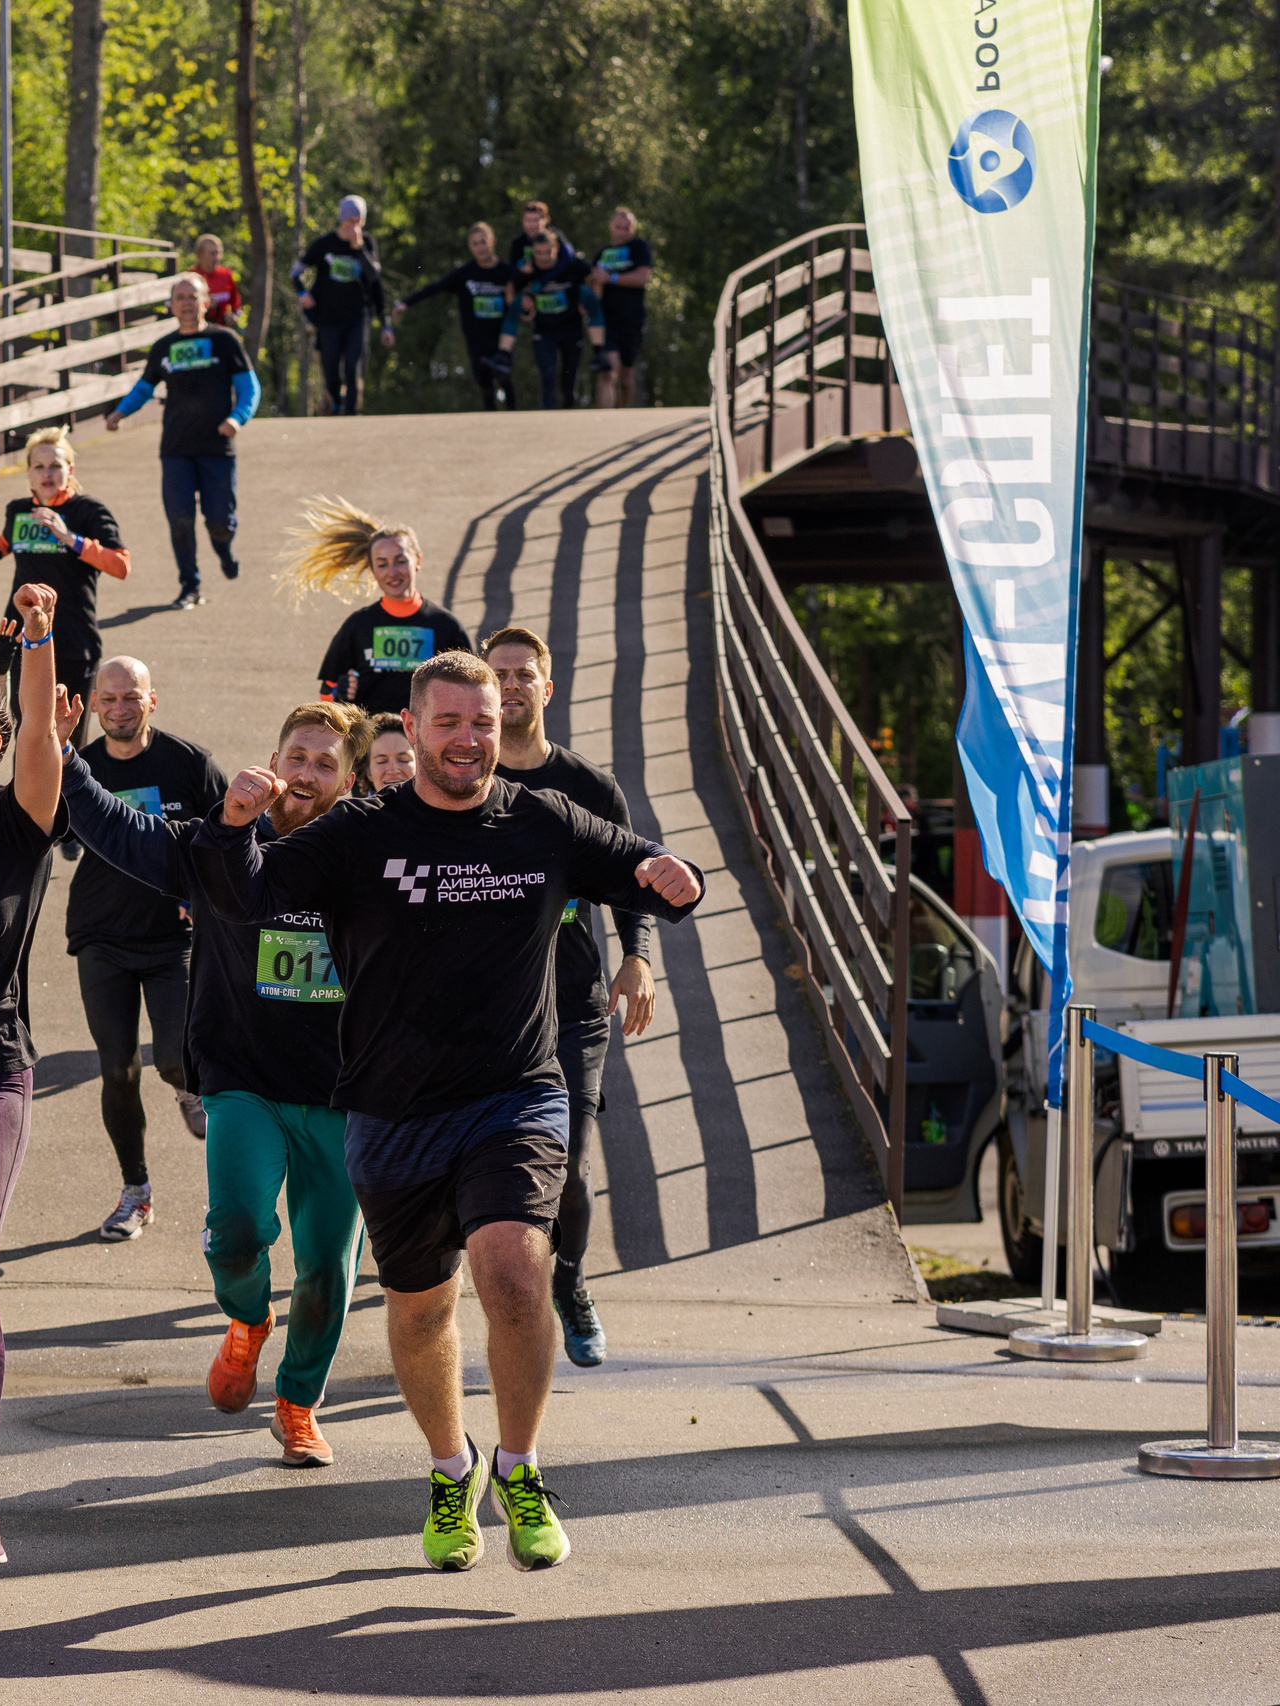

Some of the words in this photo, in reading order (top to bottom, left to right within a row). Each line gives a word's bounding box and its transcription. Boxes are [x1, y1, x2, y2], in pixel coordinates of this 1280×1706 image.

[383, 638, 425, 658] 007
[437, 863, 492, 877] ГОНКА
[437, 872, 546, 891] ДИВИЗИОНОВ
[437, 887, 526, 903] РОСАТОМА
[273, 950, 335, 982] 017
[260, 986, 301, 998] АТОМ-СЛЕТ
